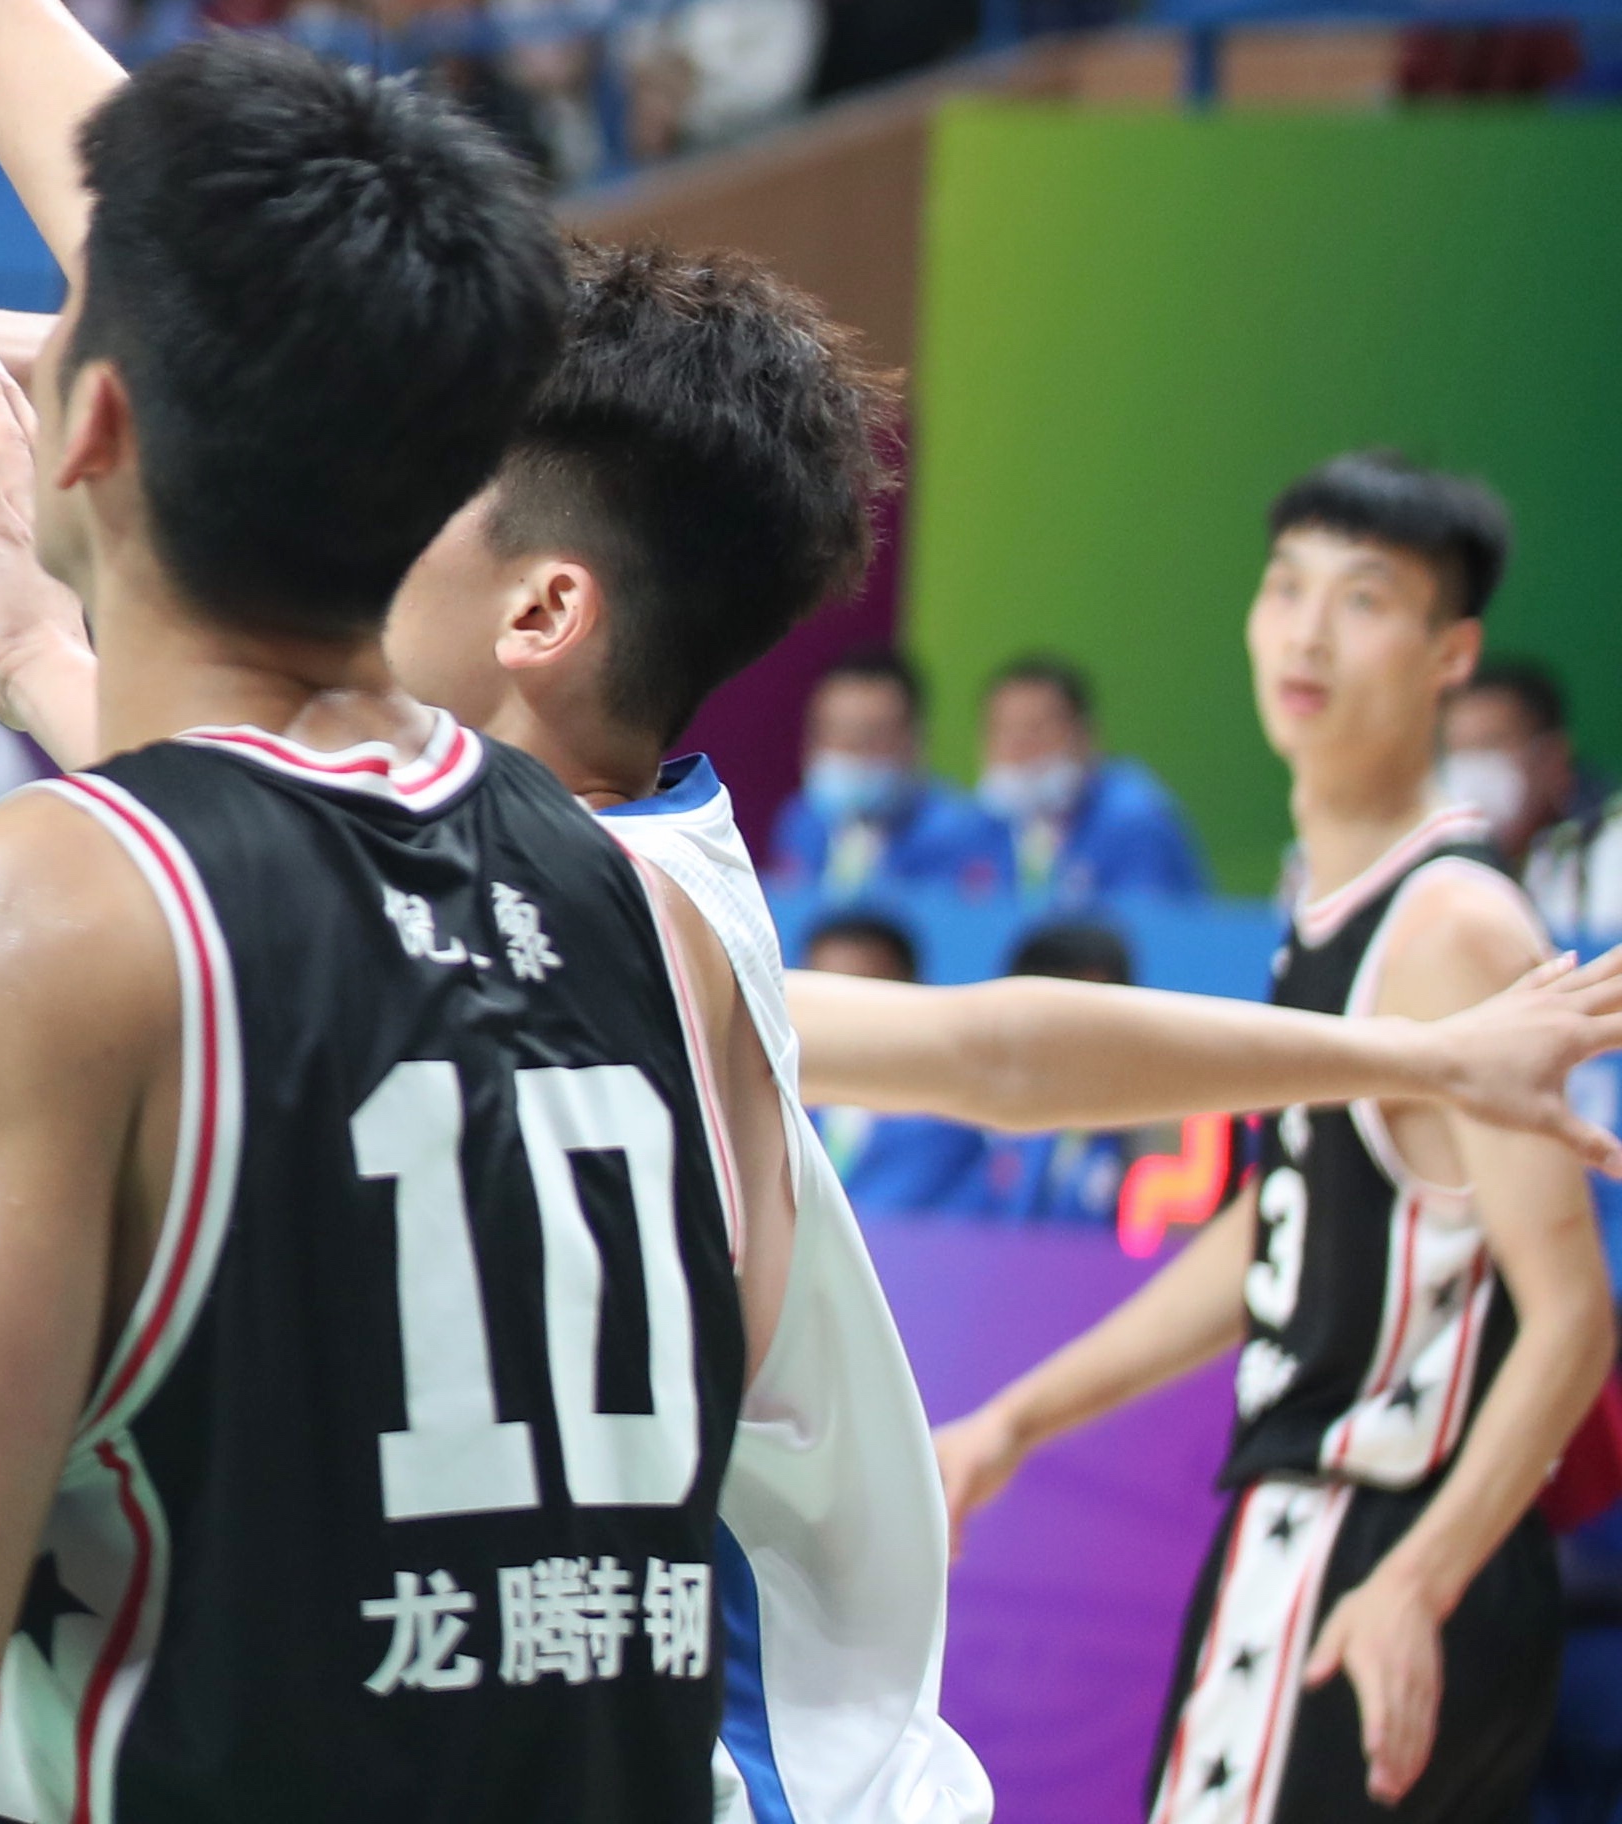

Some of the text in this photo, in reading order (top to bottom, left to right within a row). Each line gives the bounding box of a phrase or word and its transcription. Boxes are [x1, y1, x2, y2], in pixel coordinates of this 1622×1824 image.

[347, 1059, 701, 1524] 10
[359, 1554, 712, 1697] 龙腾特钢
